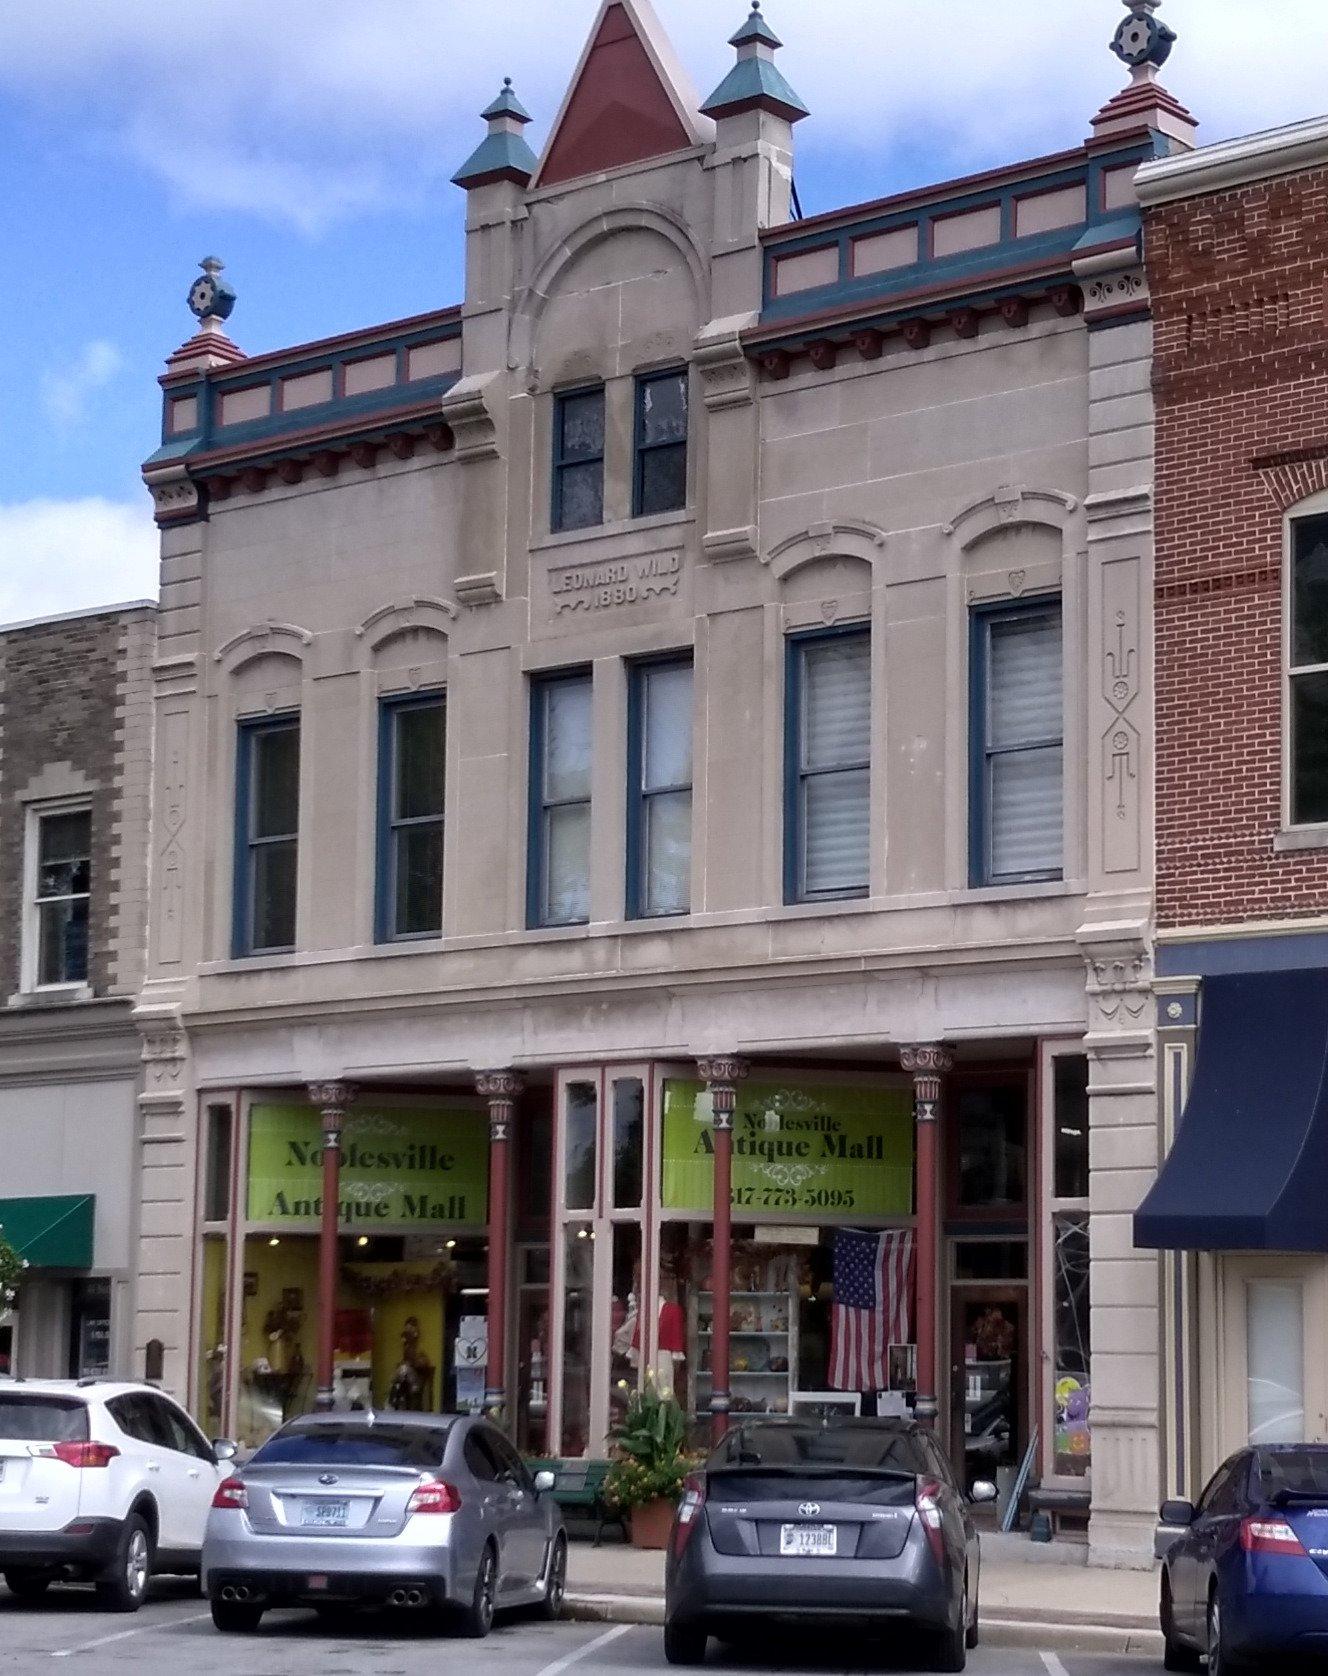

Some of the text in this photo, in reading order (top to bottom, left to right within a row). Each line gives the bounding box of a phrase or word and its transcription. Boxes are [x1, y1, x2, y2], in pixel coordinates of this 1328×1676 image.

[562, 554, 680, 592] EDWARD WILD
[595, 585, 638, 609] 1880
[743, 1112, 843, 1133] Nolesville
[693, 1129, 884, 1163] Atique Mall
[267, 1190, 467, 1224] Antque Mall
